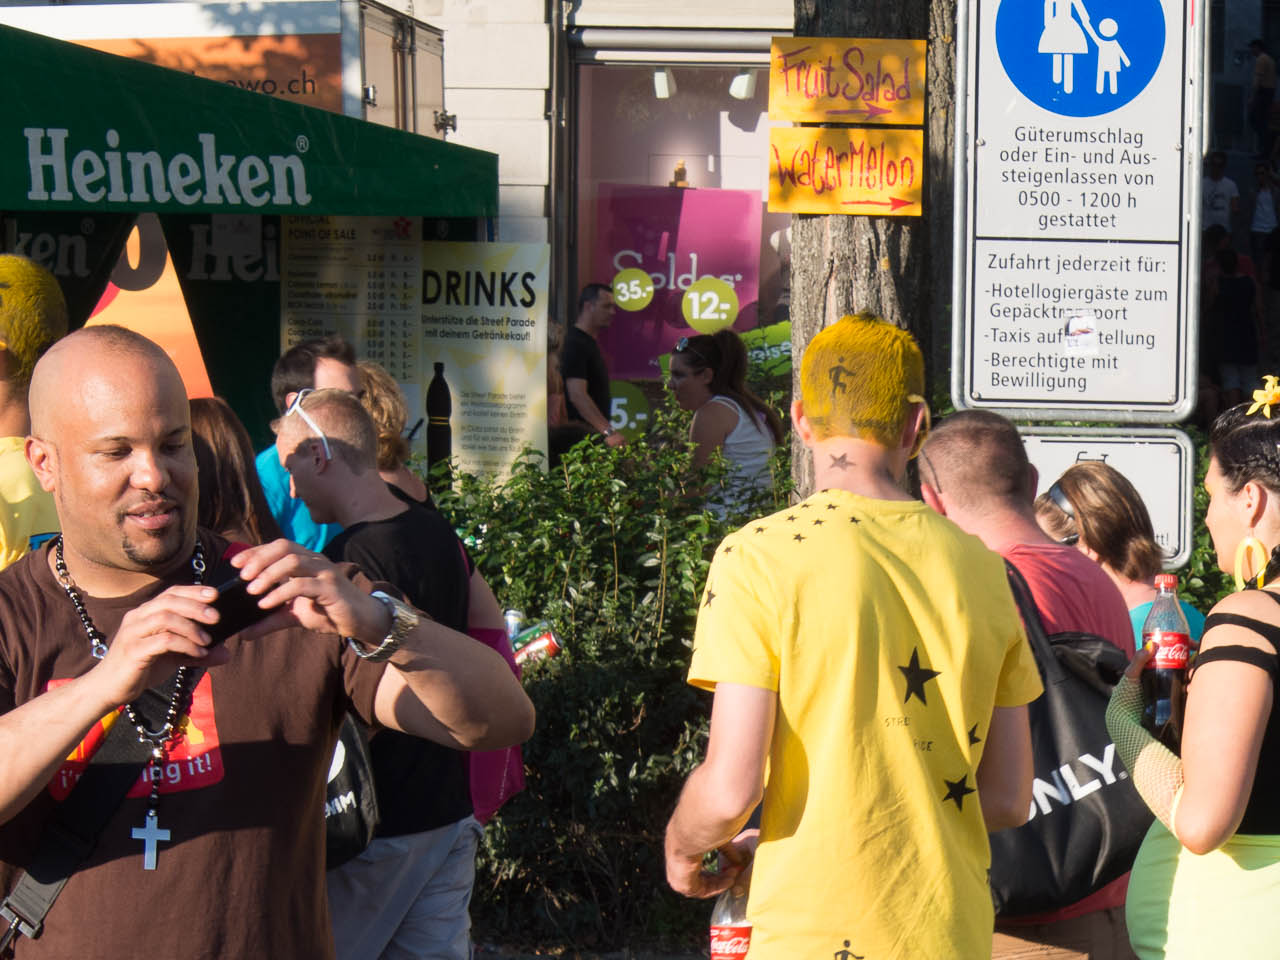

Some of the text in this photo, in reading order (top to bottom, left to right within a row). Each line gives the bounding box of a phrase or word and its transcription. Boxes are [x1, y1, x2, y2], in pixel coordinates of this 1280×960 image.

[777, 45, 911, 103] Fruit Salad
[1014, 126, 1143, 148] Güterumschlag
[1000, 146, 1157, 165] oder Ein- und Aus-
[1002, 168, 1154, 187] steigenlassen von
[1018, 190, 1061, 207] 0500
[1080, 192, 1121, 208] 1200
[1127, 192, 1137, 208] h
[1038, 214, 1117, 230] gestattet
[988, 253, 1167, 274] Zufahrt jederzeit für:
[421, 270, 536, 308] DRINKS
[1135, 288, 1168, 301] zum
[990, 302, 1128, 322] Gepäcktrport
[506, 317, 536, 328] Parade
[1036, 328, 1063, 343] auf
[1092, 354, 1119, 369] mit
[991, 372, 1087, 392] Bewilligung
[186, 751, 213, 777] it!
[1028, 743, 1118, 822] NLY
